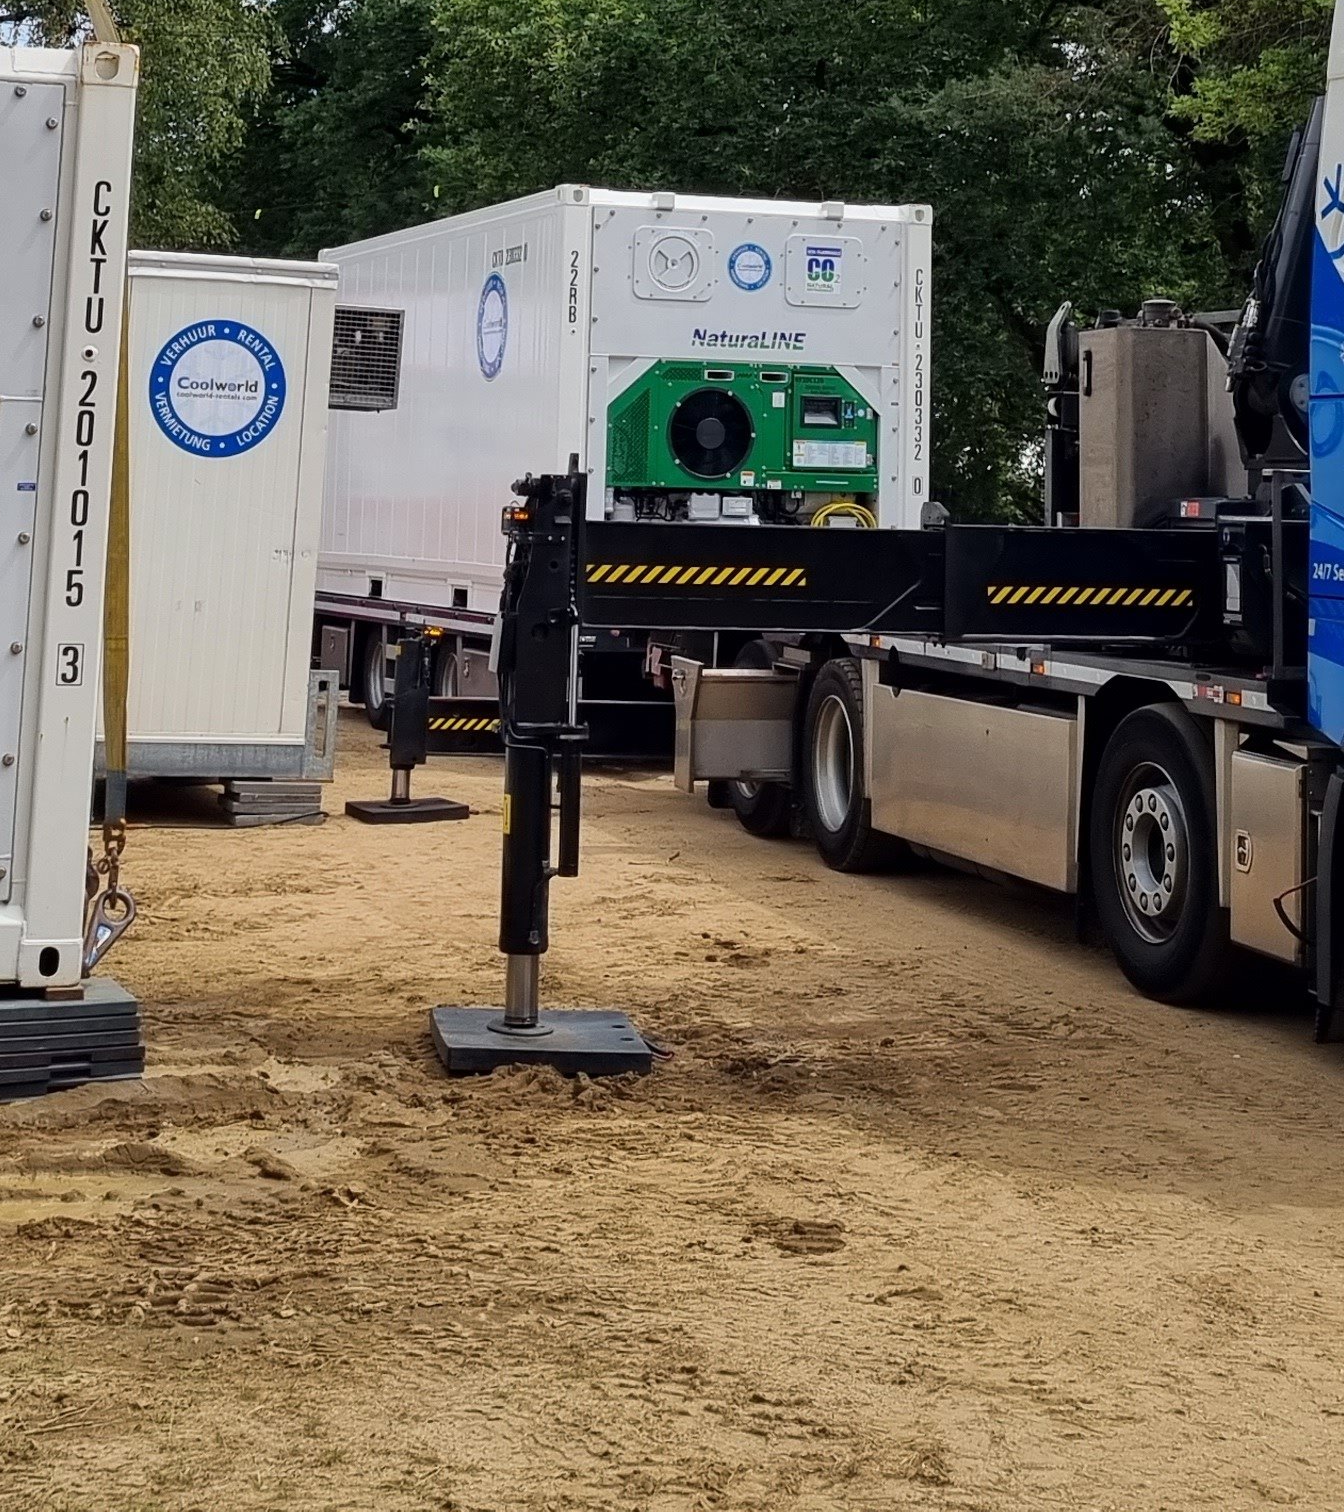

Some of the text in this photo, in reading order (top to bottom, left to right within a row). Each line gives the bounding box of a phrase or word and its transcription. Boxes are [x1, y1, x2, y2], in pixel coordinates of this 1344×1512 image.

[568, 250, 579, 324] 22RB
[914, 268, 924, 339] CKTU
[159, 324, 216, 368] VERHUUR
[236, 329, 276, 372] RENTAL
[691, 328, 807, 350] NaturaLINE
[177, 376, 259, 393] Coolworld
[60, 180, 112, 685] CKTU 201015 3
[155, 391, 212, 451] VERMIETUNG
[236, 395, 279, 447] LOCATION
[1312, 562, 1333, 580] 24/7
